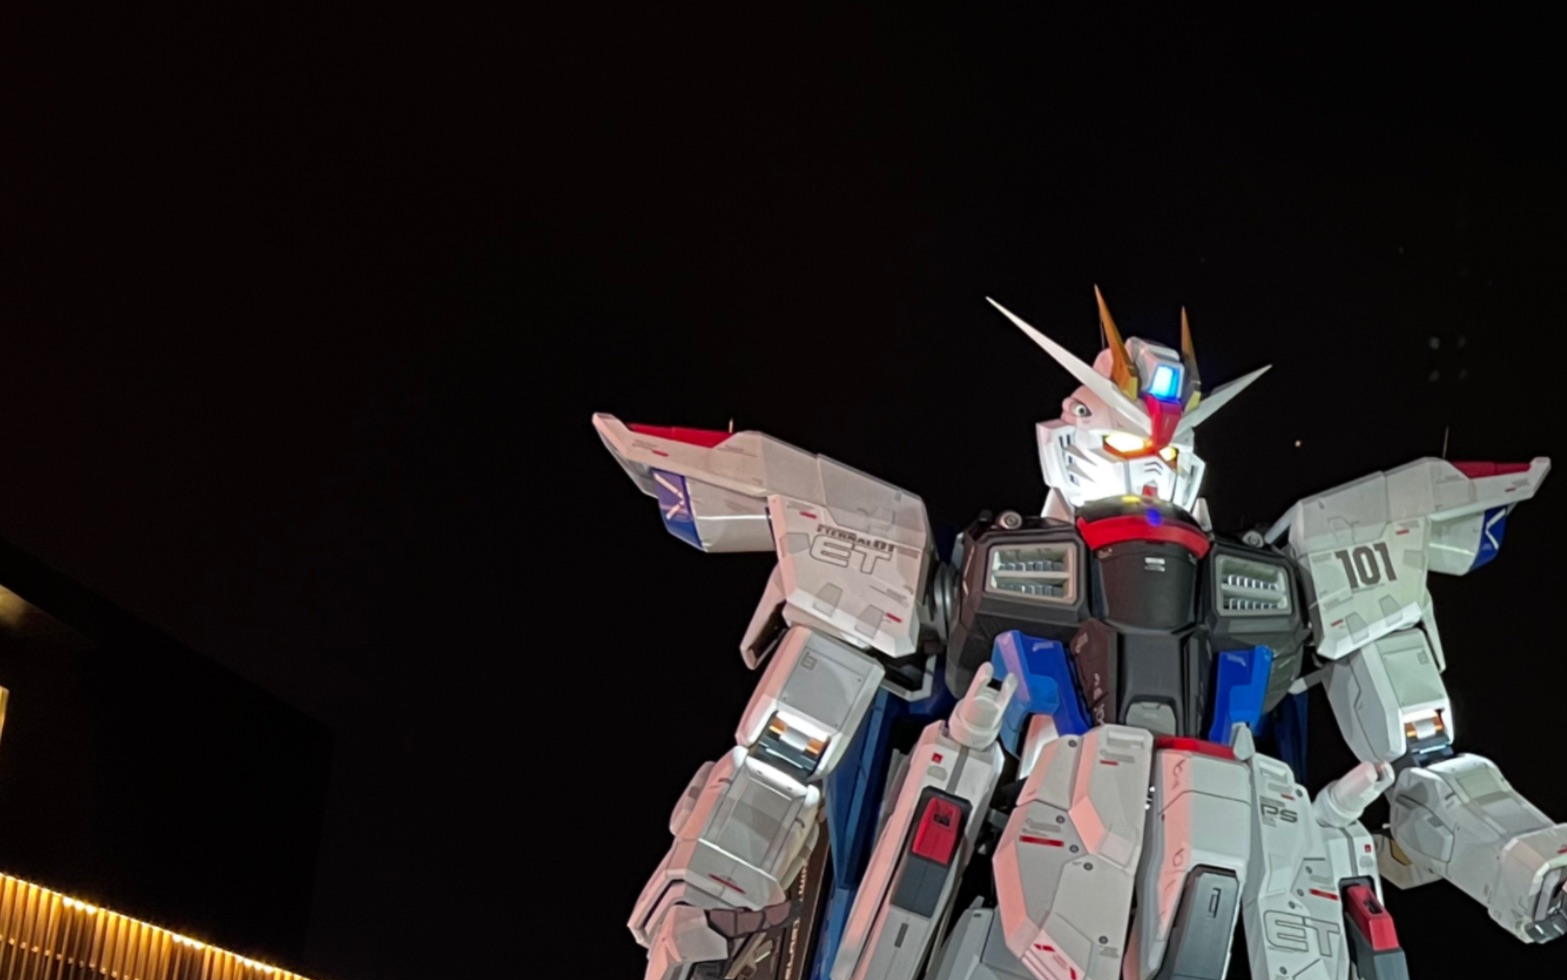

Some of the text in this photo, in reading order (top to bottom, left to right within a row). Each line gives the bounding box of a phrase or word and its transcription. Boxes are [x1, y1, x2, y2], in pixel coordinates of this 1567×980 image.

[810, 534, 892, 574] ET
[1334, 542, 1397, 588] 101
[1260, 804, 1298, 823] PS
[1264, 910, 1340, 957] ET
